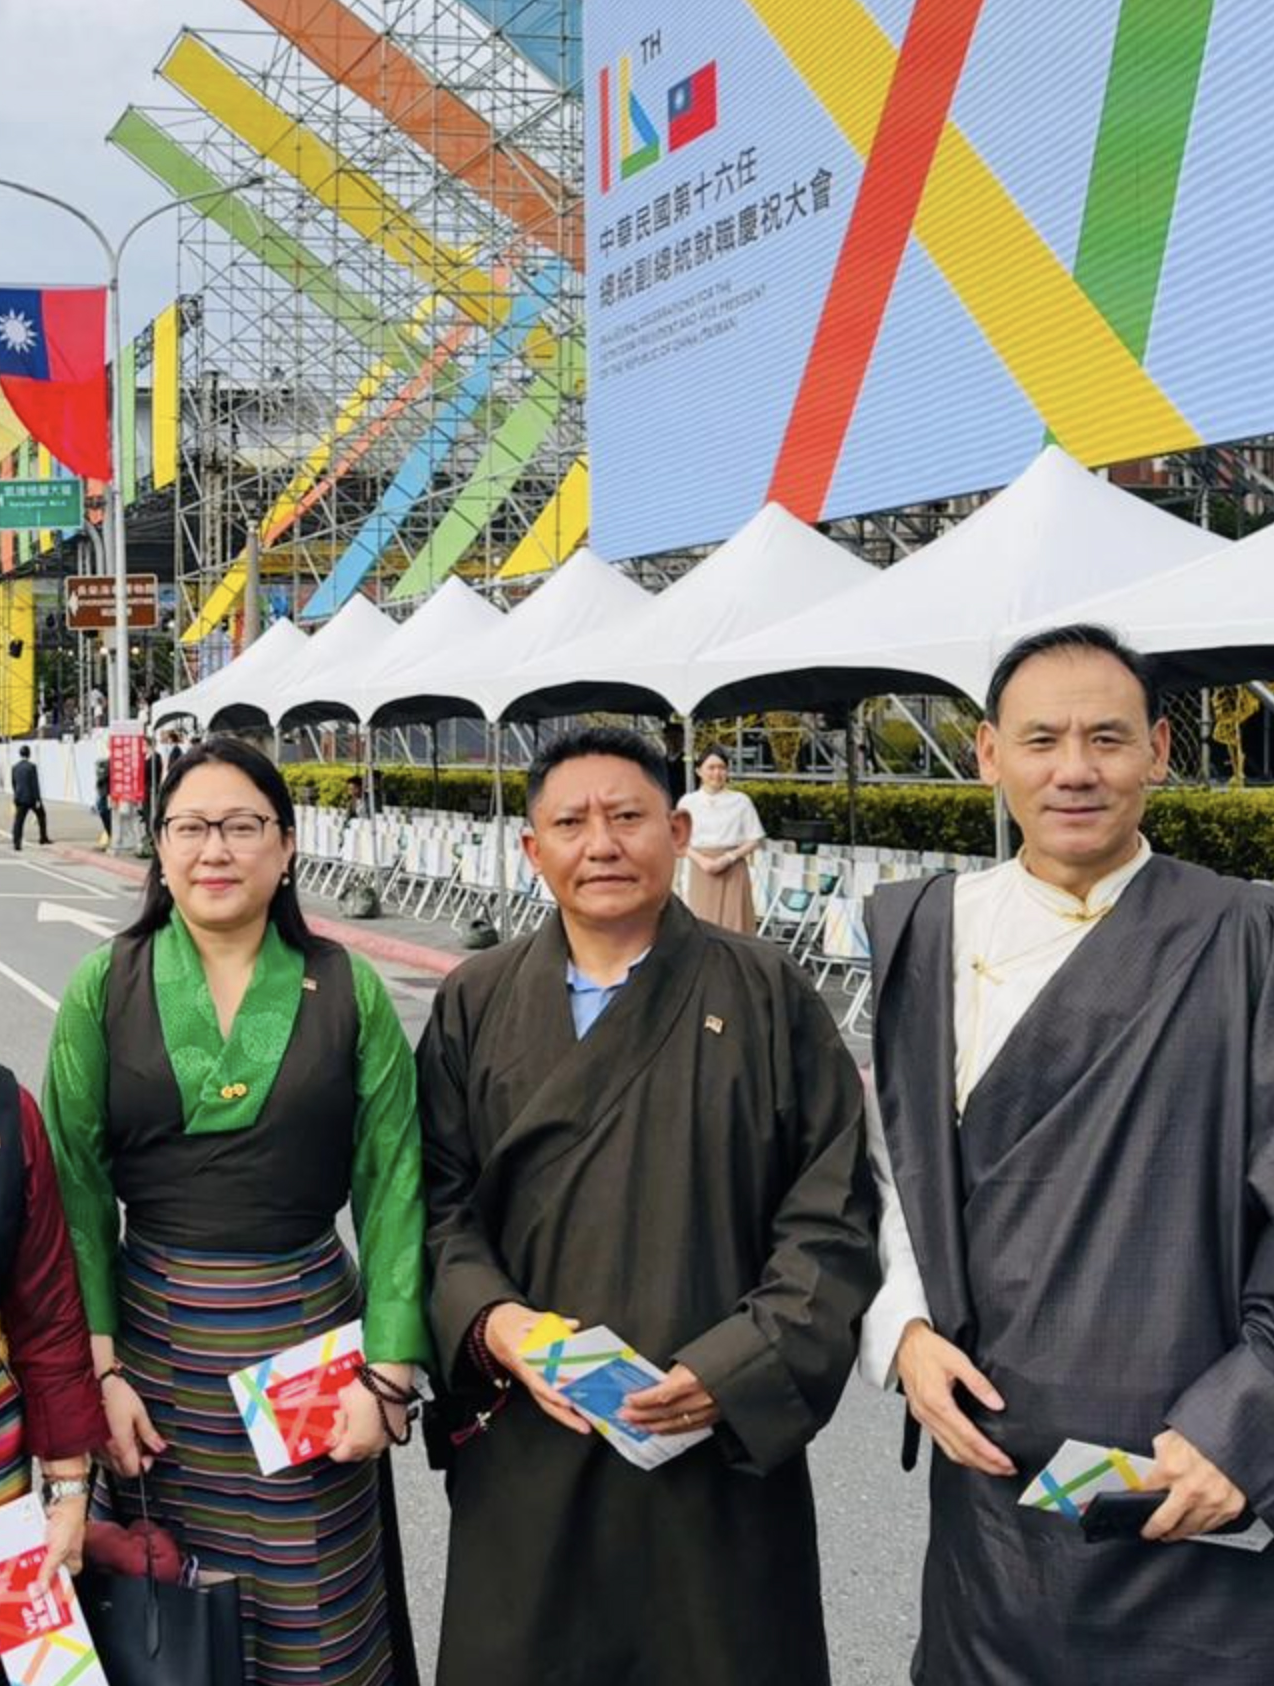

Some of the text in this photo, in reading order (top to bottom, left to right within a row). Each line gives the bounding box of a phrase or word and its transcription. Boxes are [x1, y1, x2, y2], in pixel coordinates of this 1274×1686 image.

[640, 29, 662, 66] TH
[599, 146, 757, 258] 中華民國第十六任
[599, 167, 833, 308] 總統副總統就職慶祝大會
